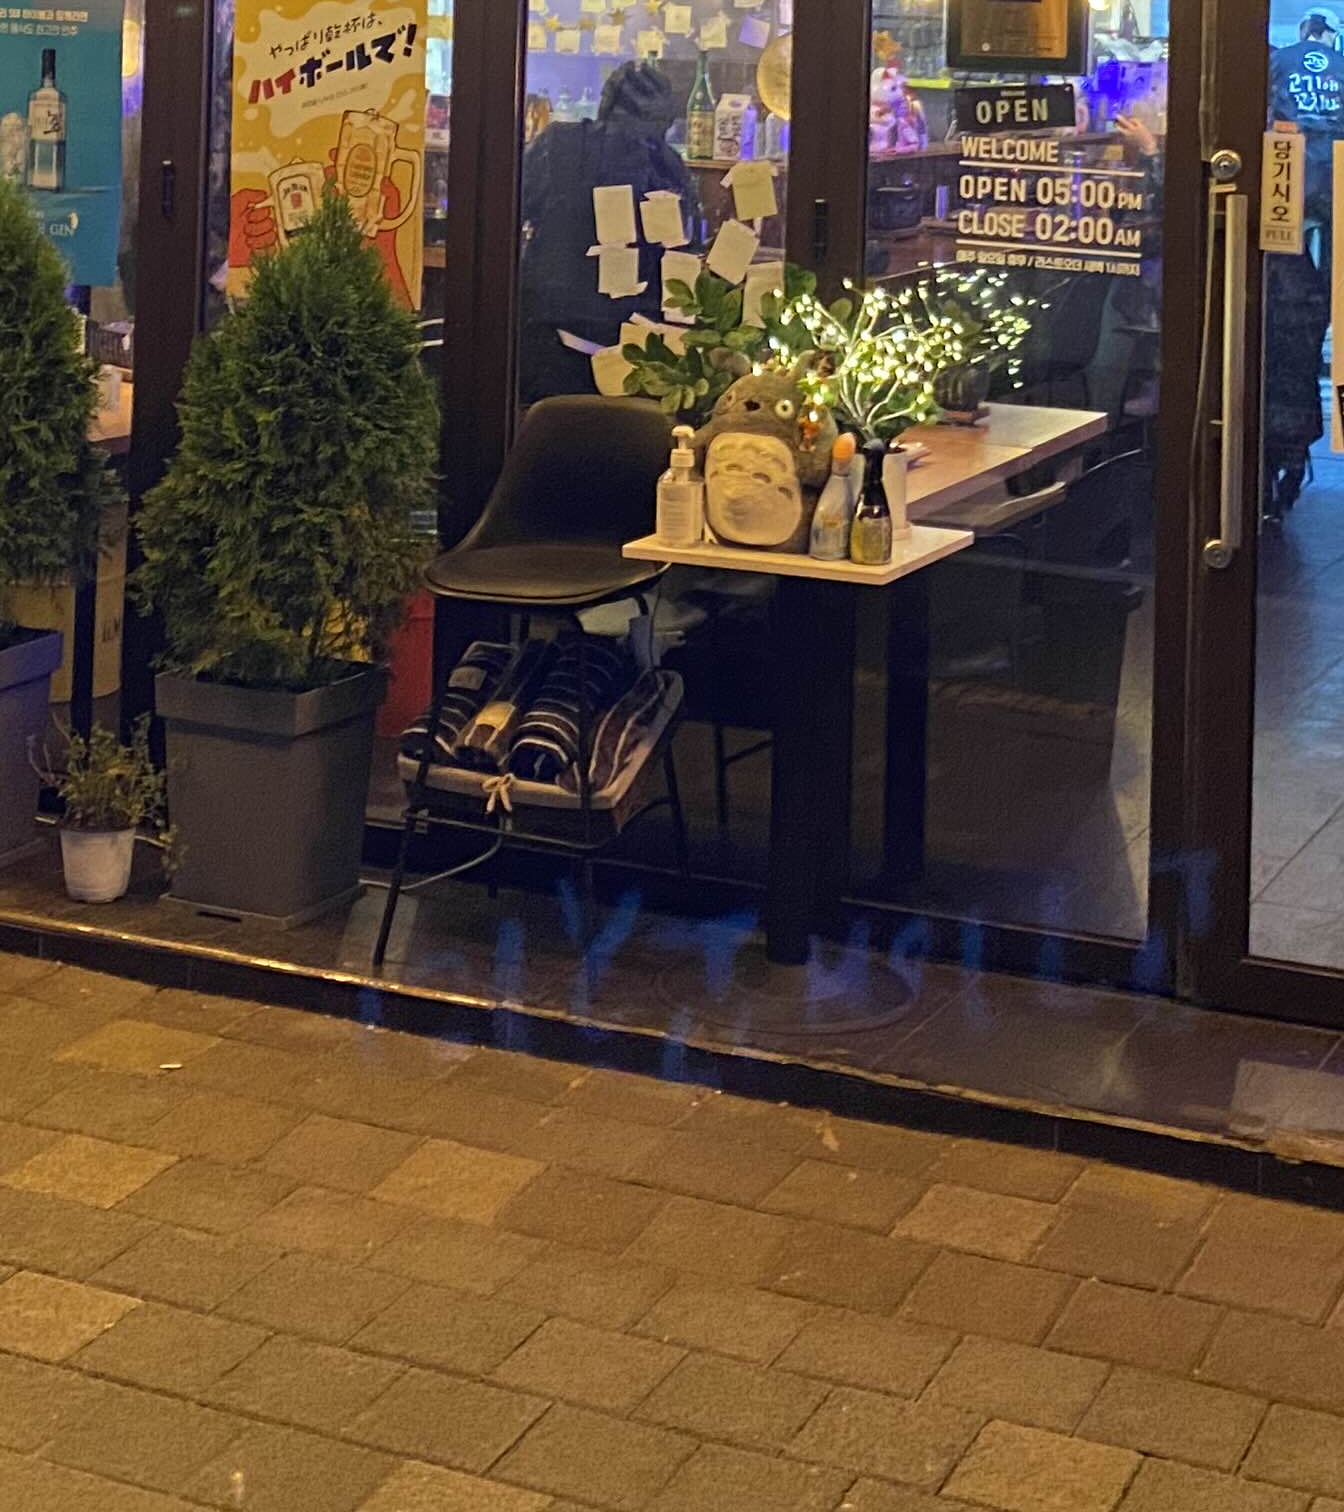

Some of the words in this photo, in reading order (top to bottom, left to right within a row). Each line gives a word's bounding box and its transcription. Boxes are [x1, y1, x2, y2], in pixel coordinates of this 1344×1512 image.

[975, 97, 1050, 124] OPEN
[961, 136, 1060, 163] WELCOME
[959, 174, 1027, 203] OPEN
[1036, 176, 1116, 209] 05:00
[1117, 191, 1143, 210] PM
[1271, 140, 1293, 224] 당기시오
[958, 210, 1025, 238] CLOSE
[1035, 213, 1114, 245] 02:00
[1114, 229, 1141, 247] AM
